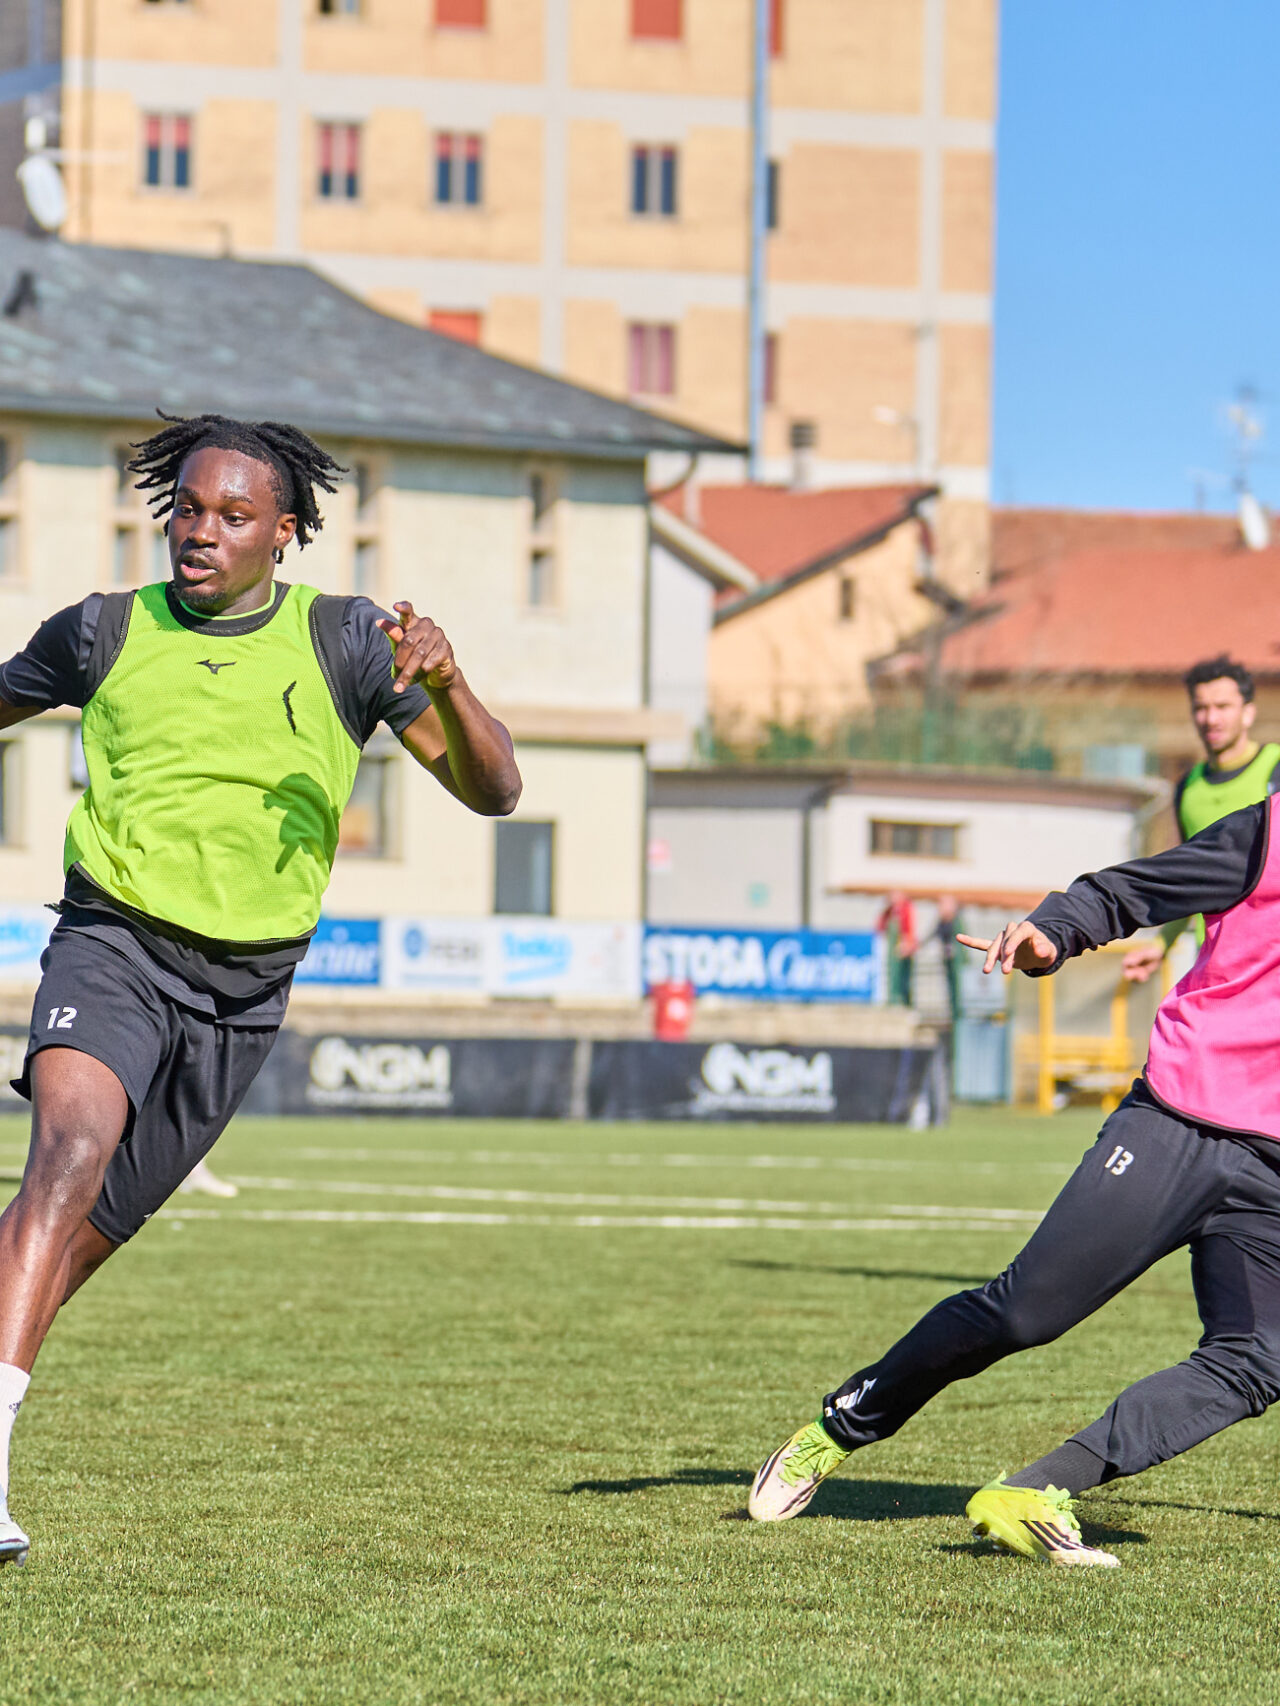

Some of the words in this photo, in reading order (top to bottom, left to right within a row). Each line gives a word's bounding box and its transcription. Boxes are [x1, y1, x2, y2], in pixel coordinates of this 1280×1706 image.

[645, 934, 766, 988] STOSA
[769, 939, 875, 991] Cucine
[47, 1006, 77, 1030] 12
[310, 1037, 451, 1092] NGM
[701, 1042, 832, 1096] NGM
[1104, 1145, 1134, 1176] 13
